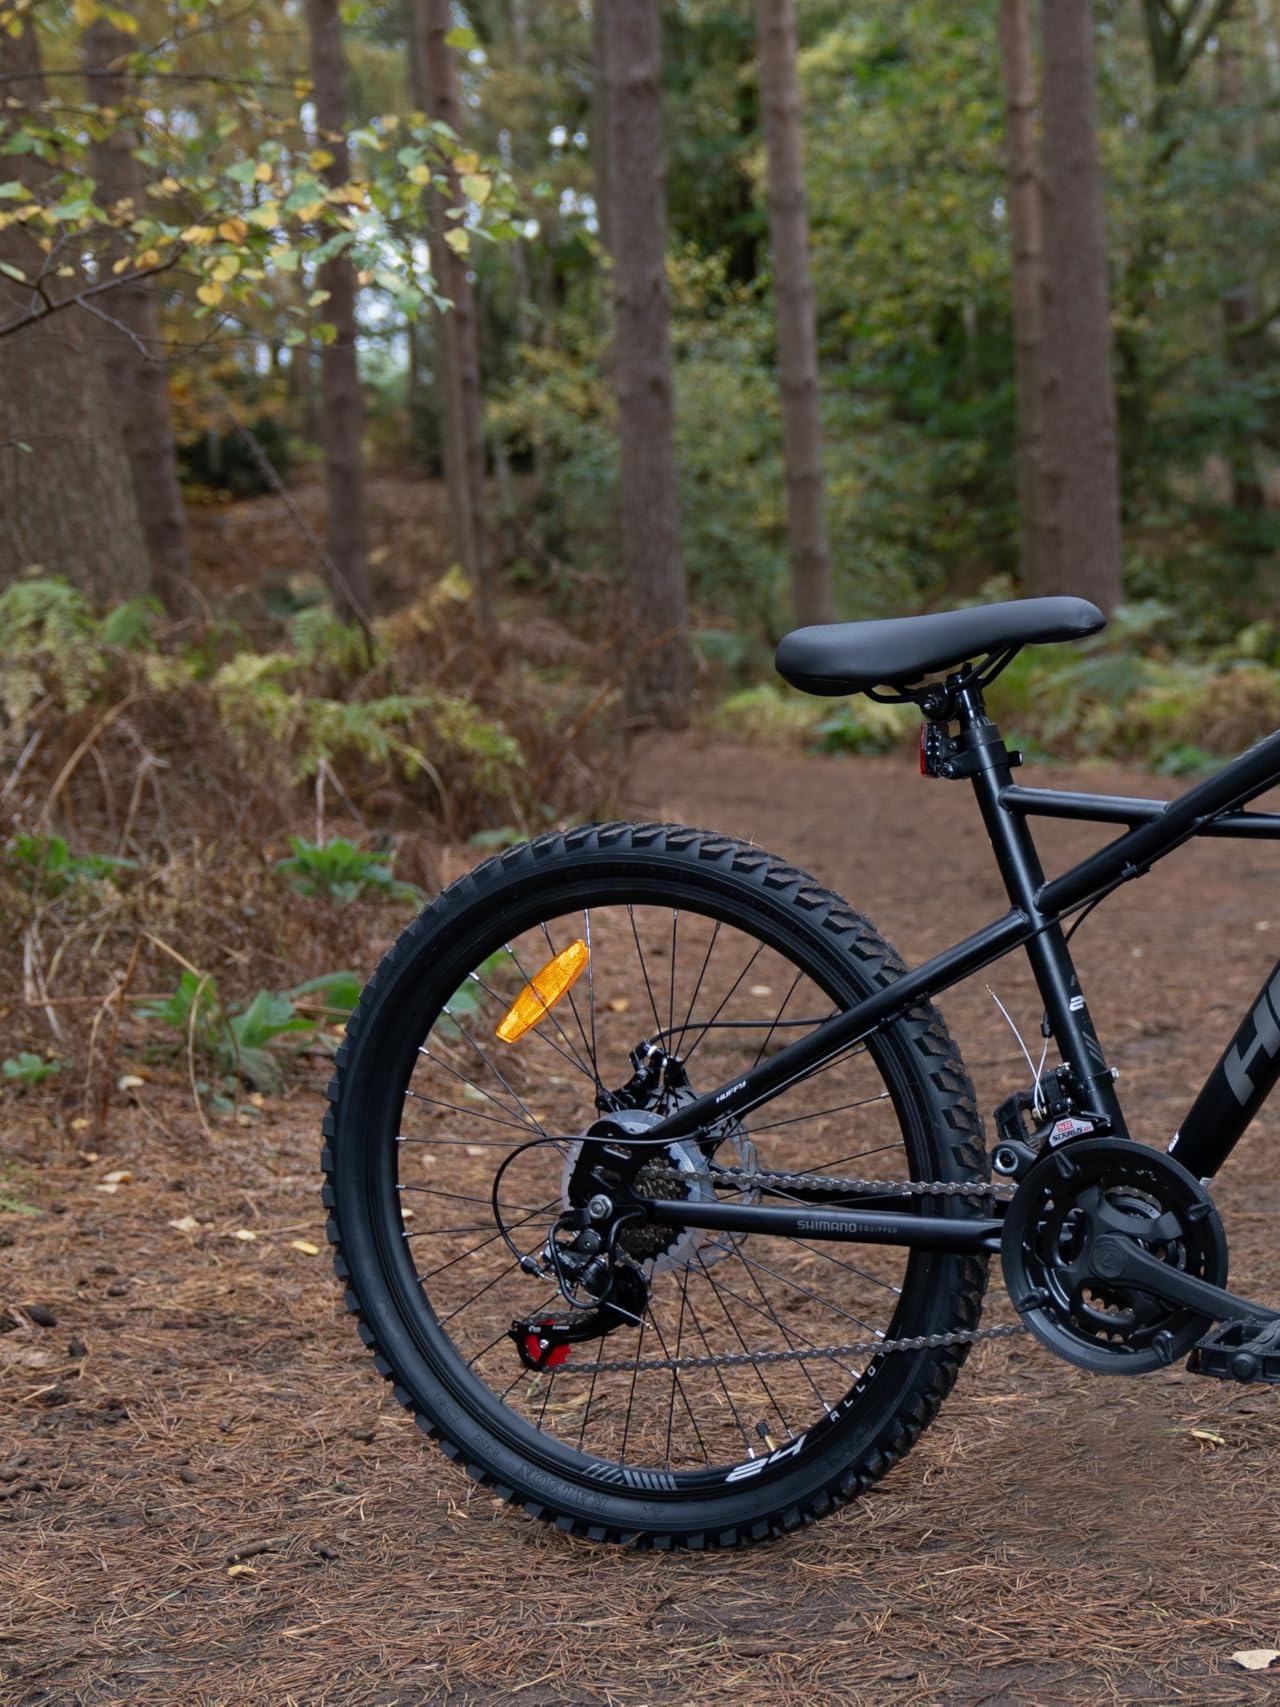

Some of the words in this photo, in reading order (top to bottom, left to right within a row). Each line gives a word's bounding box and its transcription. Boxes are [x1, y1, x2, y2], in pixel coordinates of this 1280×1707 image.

[716, 1080, 746, 1103] HUFFY
[1056, 1120, 1073, 1133] SR
[797, 1220, 857, 1232] SHIMANO
[858, 1225, 898, 1234] EQUIPPED
[724, 1434, 807, 1483] 24
